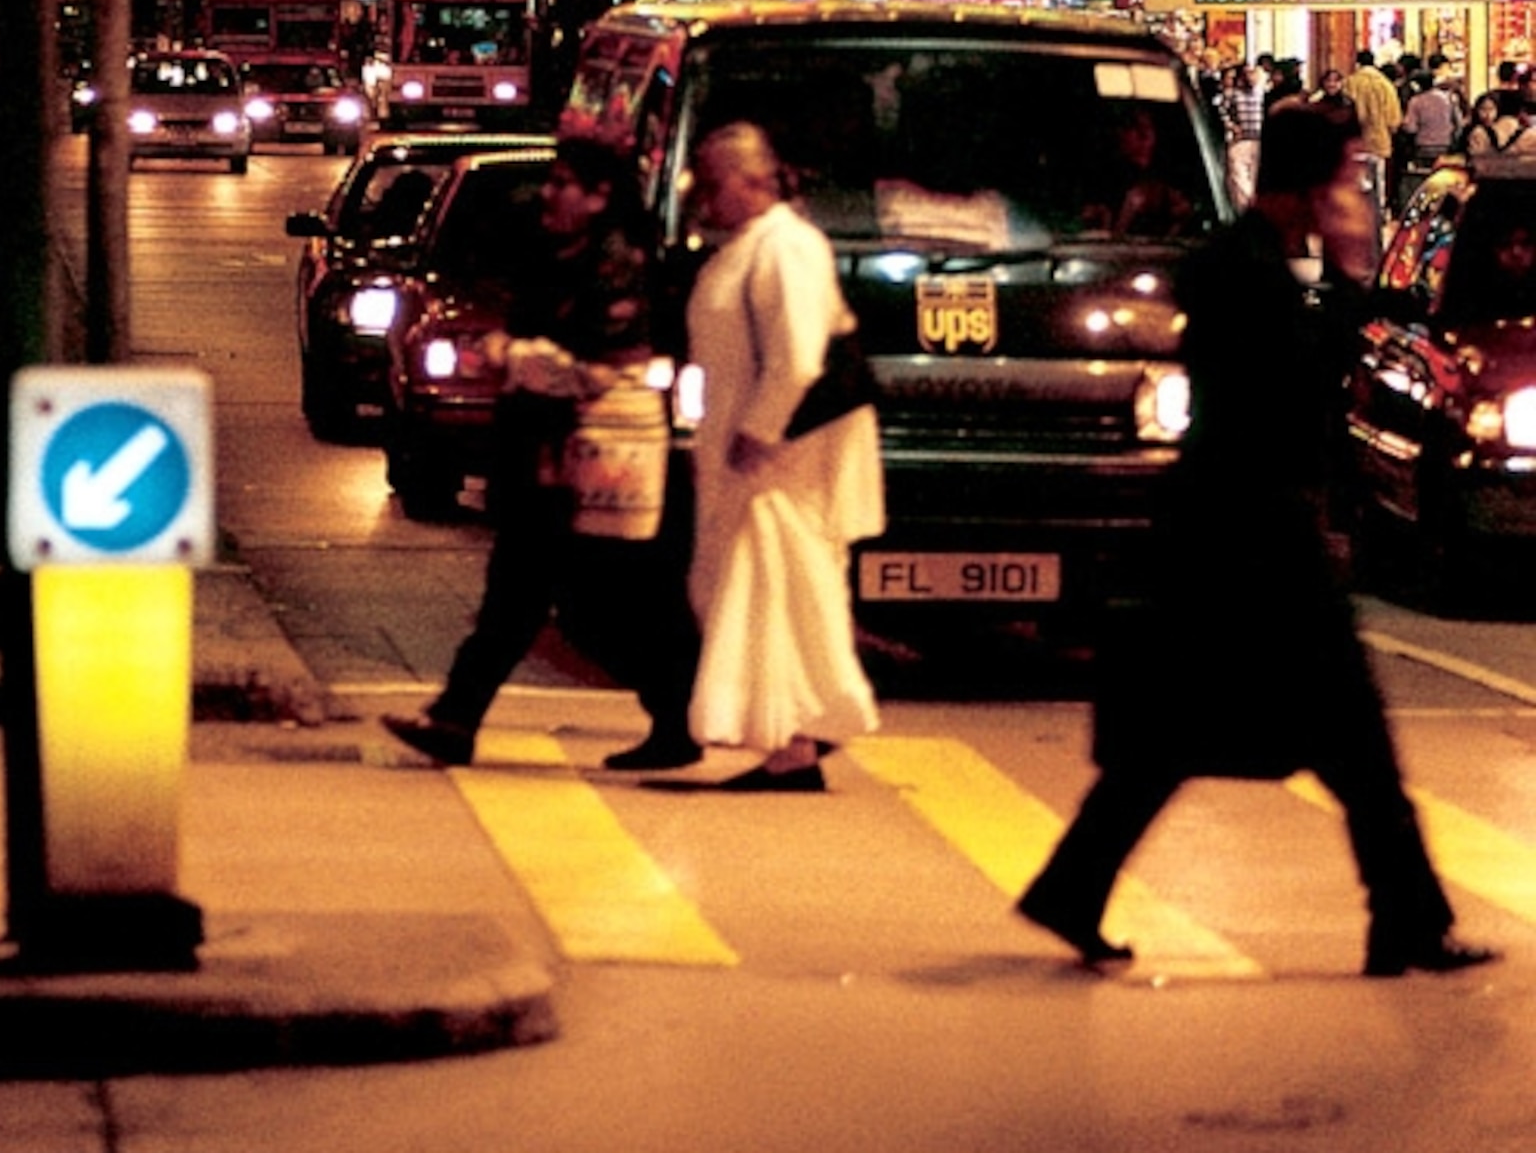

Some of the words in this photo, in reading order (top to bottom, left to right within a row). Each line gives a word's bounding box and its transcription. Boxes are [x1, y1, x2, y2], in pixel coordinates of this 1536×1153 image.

[924, 308, 990, 352] ups
[880, 562, 932, 593] FL
[961, 562, 1039, 594] 9101
